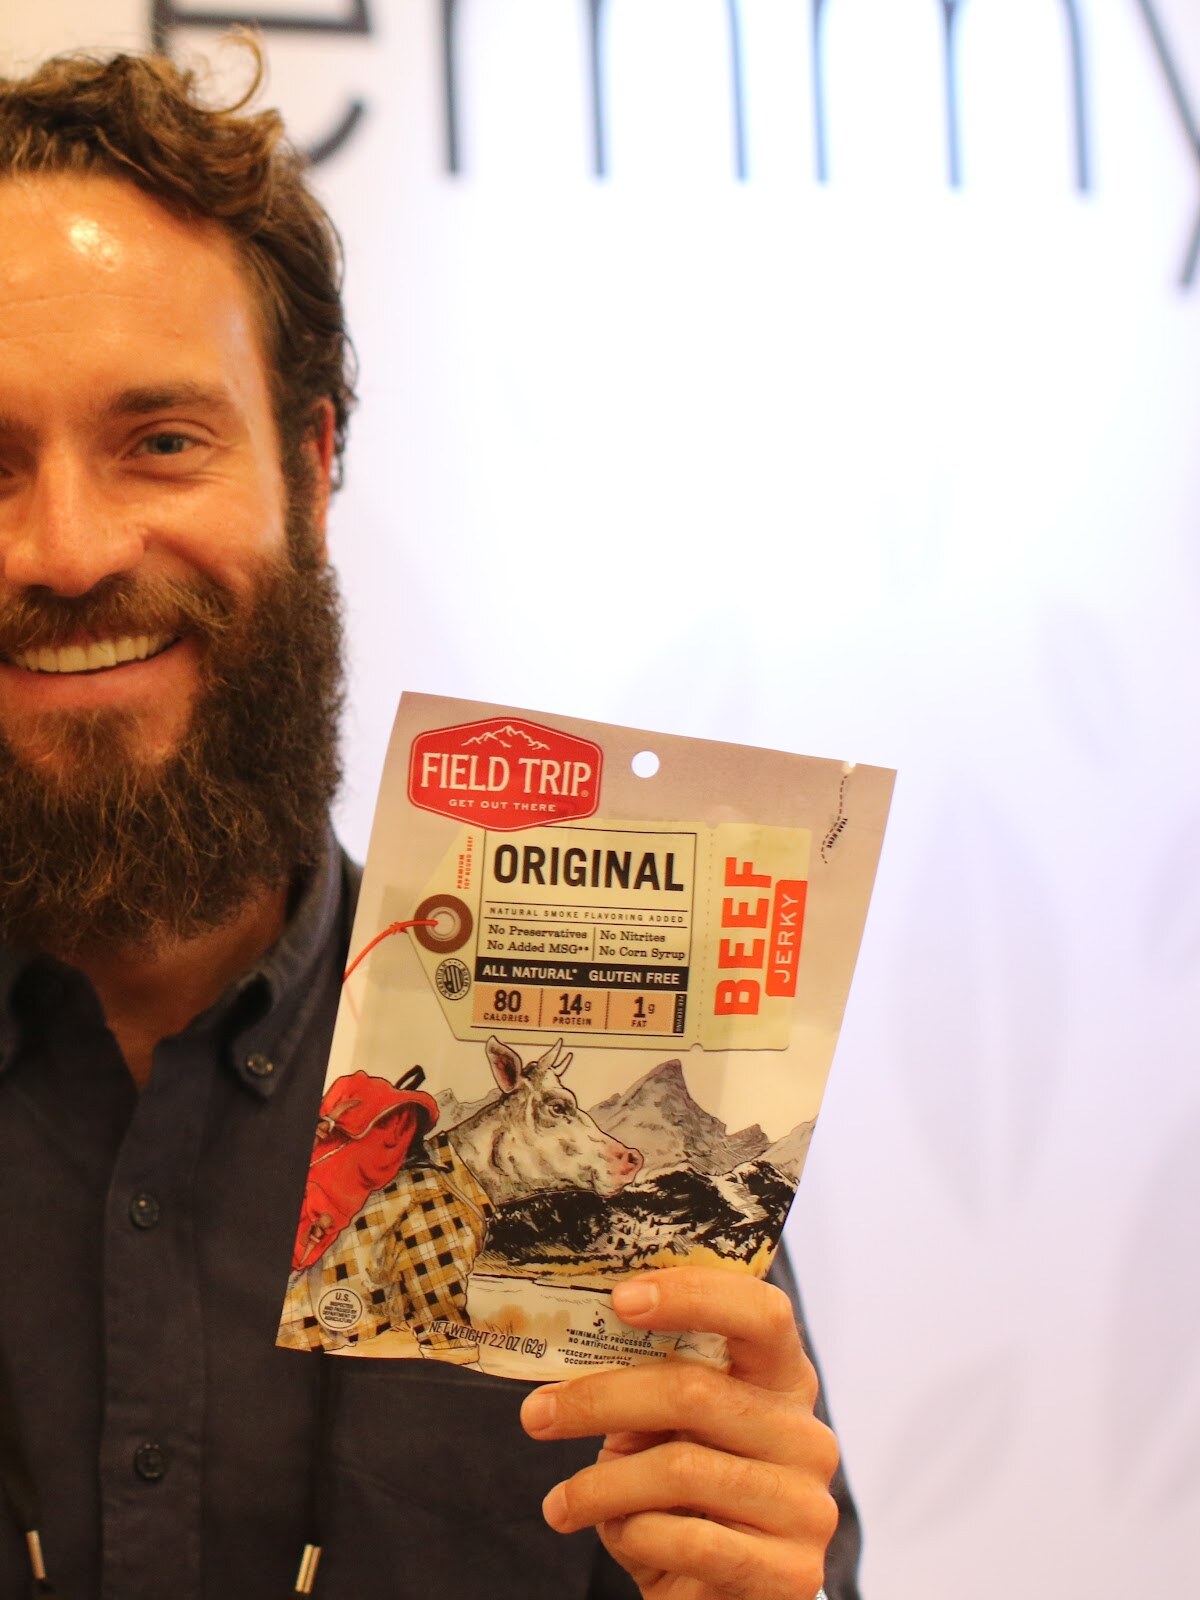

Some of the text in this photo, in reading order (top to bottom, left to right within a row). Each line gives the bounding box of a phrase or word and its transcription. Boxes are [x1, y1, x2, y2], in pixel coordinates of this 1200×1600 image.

[420, 752, 510, 792] FIELD
[448, 799, 556, 812] GET OUT THERE
[457, 854, 465, 889] PREMIUM
[493, 843, 685, 892] ORIGINAL
[489, 906, 684, 924] NATURAL SMOKE FLAVORING ADDED
[488, 924, 588, 939] No Preservatives
[599, 930, 666, 942] No Nitrites
[714, 857, 772, 1016] BEEF
[775, 893, 799, 984] JERKY
[487, 940, 504, 950] No
[508, 940, 545, 953] Added
[599, 945, 686, 961] No Corn Syrup
[482, 964, 507, 977] ALL
[588, 969, 642, 984] GLUTEN
[646, 972, 680, 985] FREE
[493, 989, 522, 1013] 80
[483, 1012, 530, 1023] CALORIES
[552, 1016, 592, 1026] PROTEIN
[631, 1019, 648, 1028] FAT
[335, 1291, 352, 1303] U.S.
[428, 1321, 450, 1335] NET
[450, 1324, 490, 1345] WEIGHT
[505, 1336, 521, 1351] OZ
[521, 1337, 548, 1358] (62g)
[568, 1336, 667, 1359] NO ARTIFICIAL INGREDIENTS
